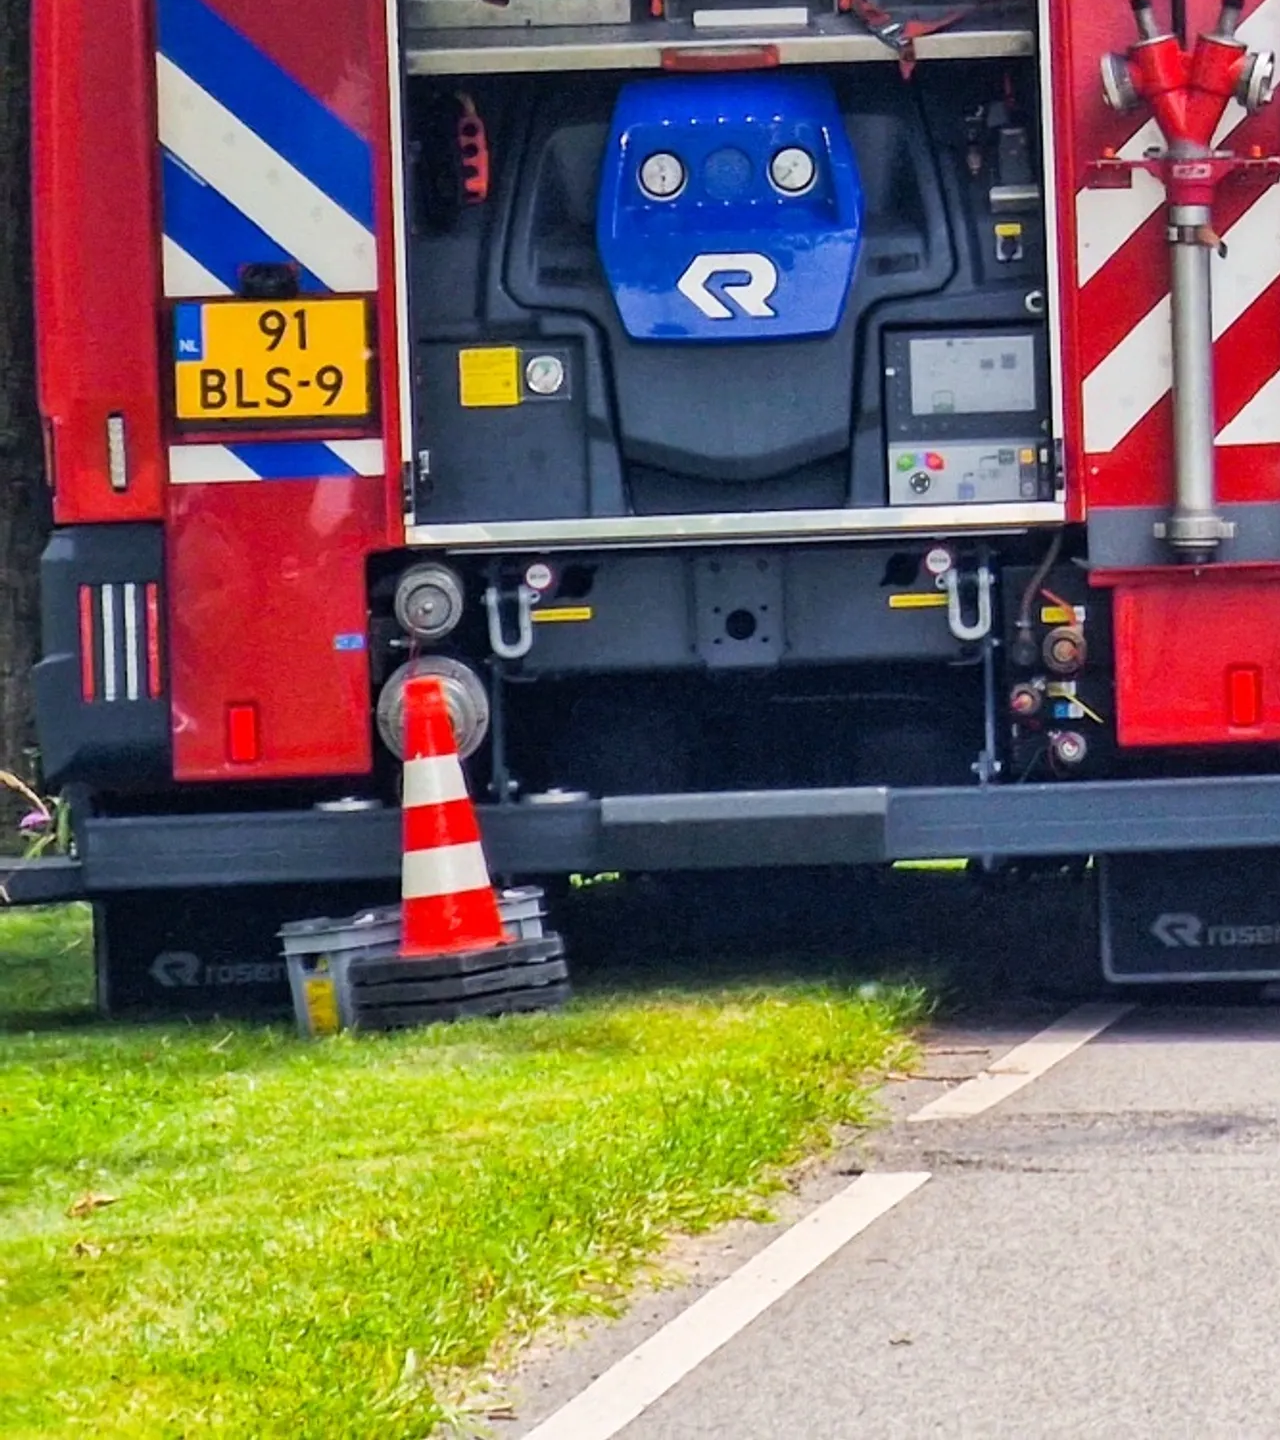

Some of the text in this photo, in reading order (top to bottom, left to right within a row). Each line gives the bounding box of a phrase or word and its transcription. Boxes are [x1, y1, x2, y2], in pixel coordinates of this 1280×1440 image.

[179, 339, 199, 353] NL
[258, 309, 307, 352] 91
[200, 365, 343, 409] BLS-9
